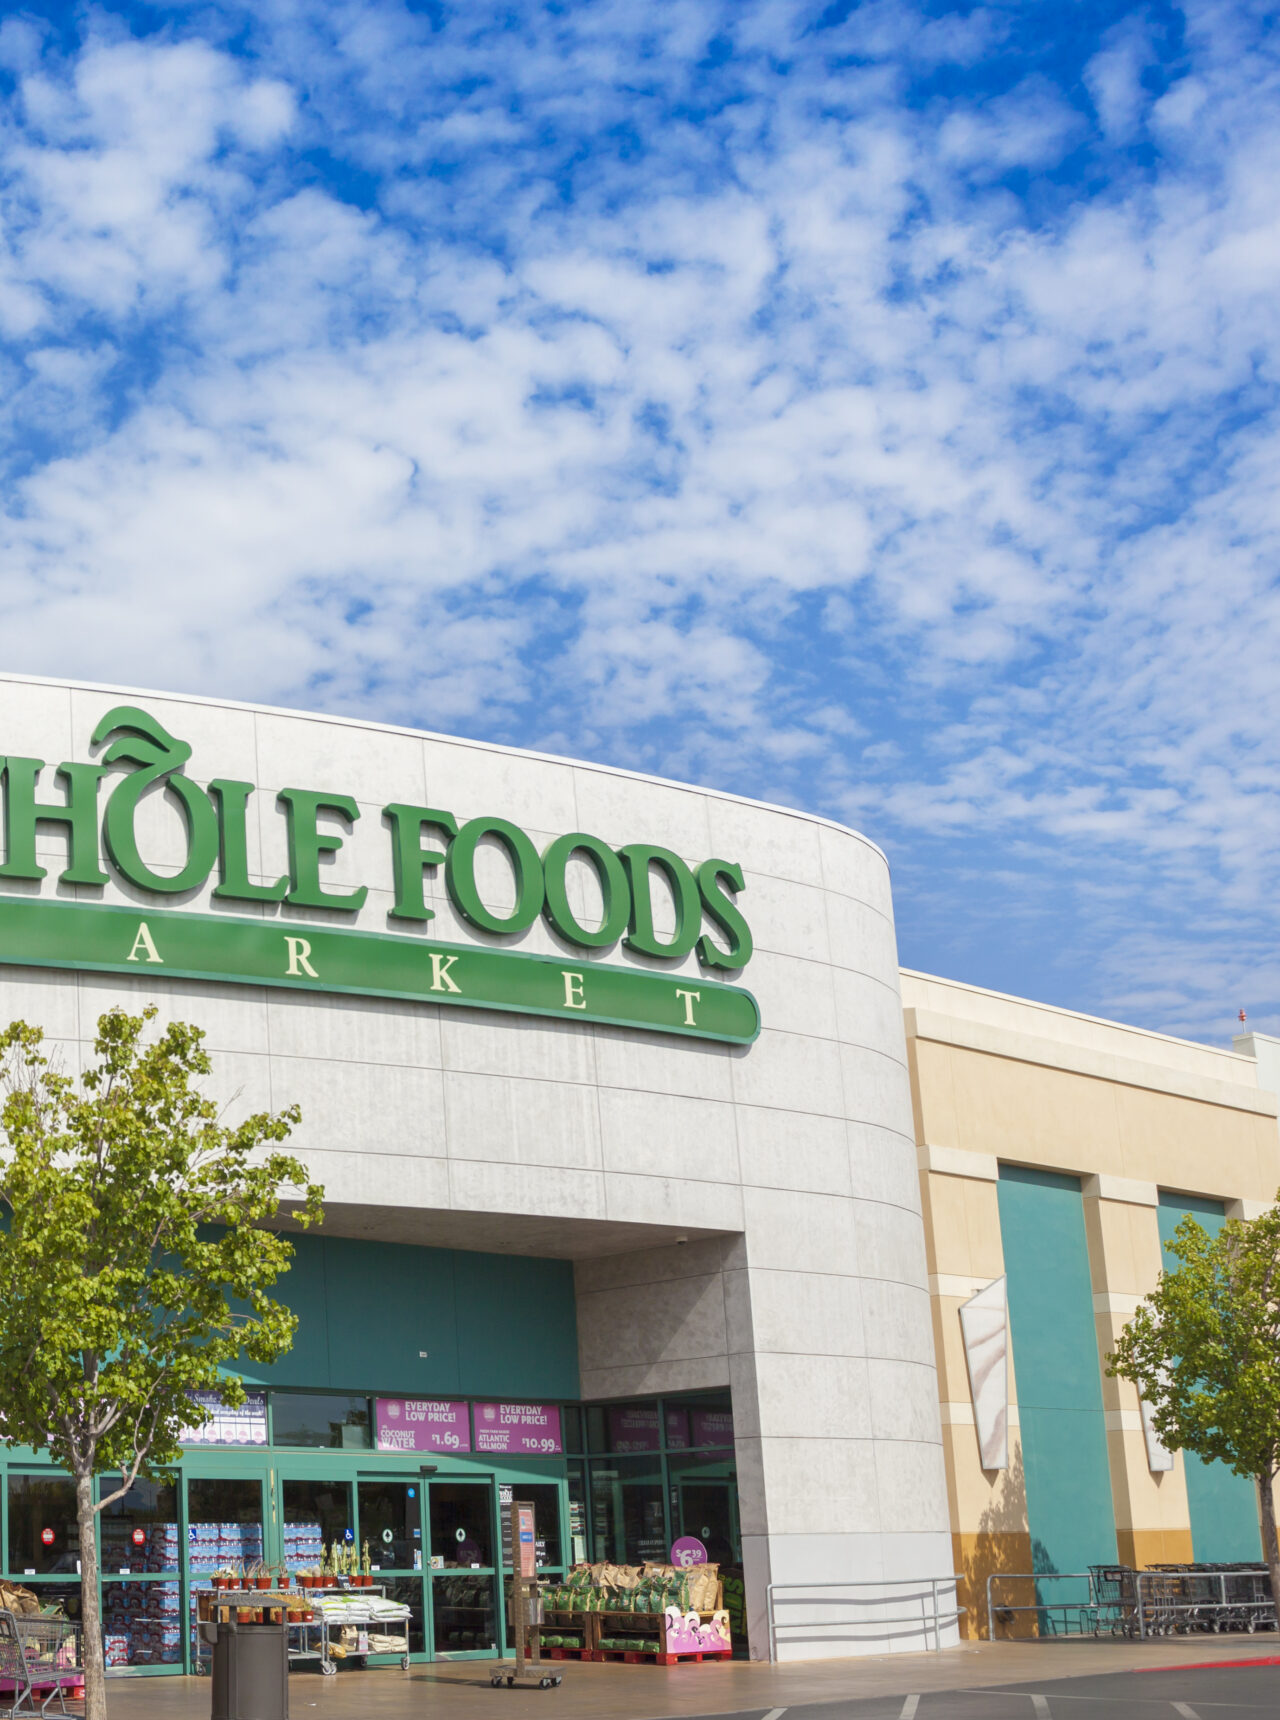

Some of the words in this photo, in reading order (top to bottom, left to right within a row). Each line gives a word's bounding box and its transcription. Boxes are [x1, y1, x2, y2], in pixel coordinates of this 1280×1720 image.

[382, 802, 754, 970] FOODS
[405, 1401, 450, 1412] EVERYDAY
[500, 1405, 542, 1415] EVERYDAY
[405, 1411, 426, 1421] LOW
[428, 1412, 456, 1422] PRICE!
[500, 1415, 519, 1424] LOW
[521, 1415, 547, 1425] PRICE!
[380, 1429, 416, 1438] COCONUT
[479, 1434, 510, 1442] ATLANTIC
[381, 1438, 416, 1448] WATER
[431, 1431, 460, 1449] $1.69
[521, 1438, 555, 1452] $10.99
[479, 1442, 507, 1450] SALMON
